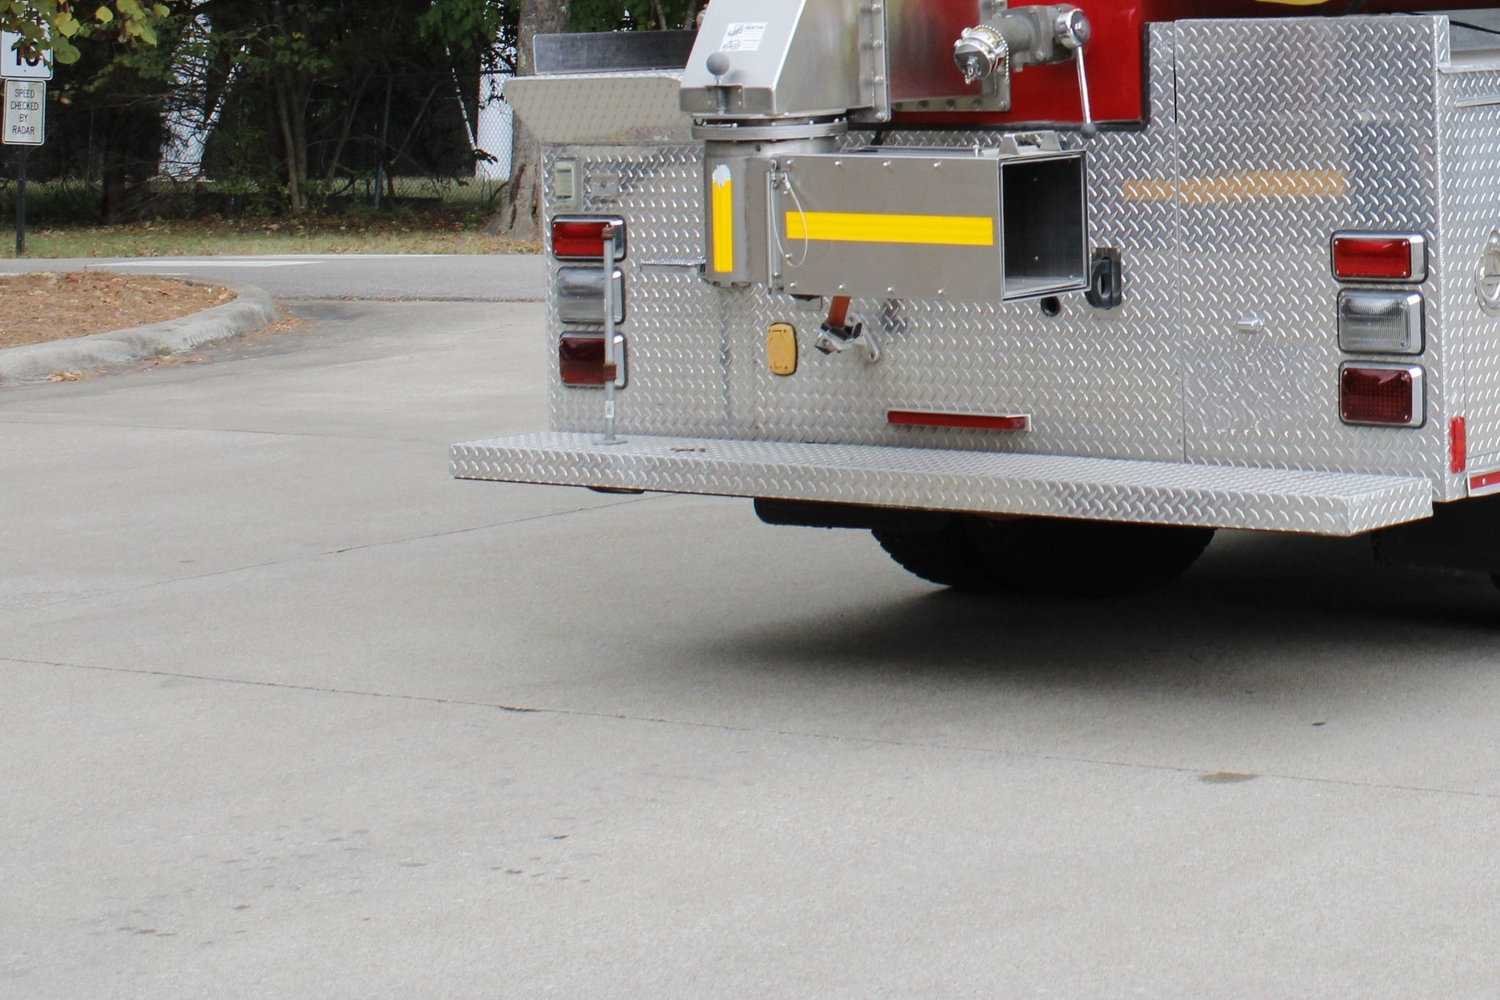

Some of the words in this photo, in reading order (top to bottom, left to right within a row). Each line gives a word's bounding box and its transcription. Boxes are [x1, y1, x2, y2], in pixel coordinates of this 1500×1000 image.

[14, 88, 36, 99] SPEED
[10, 100, 39, 111] CHECKED
[19, 113, 29, 123] BY
[12, 125, 35, 135] RADAR
